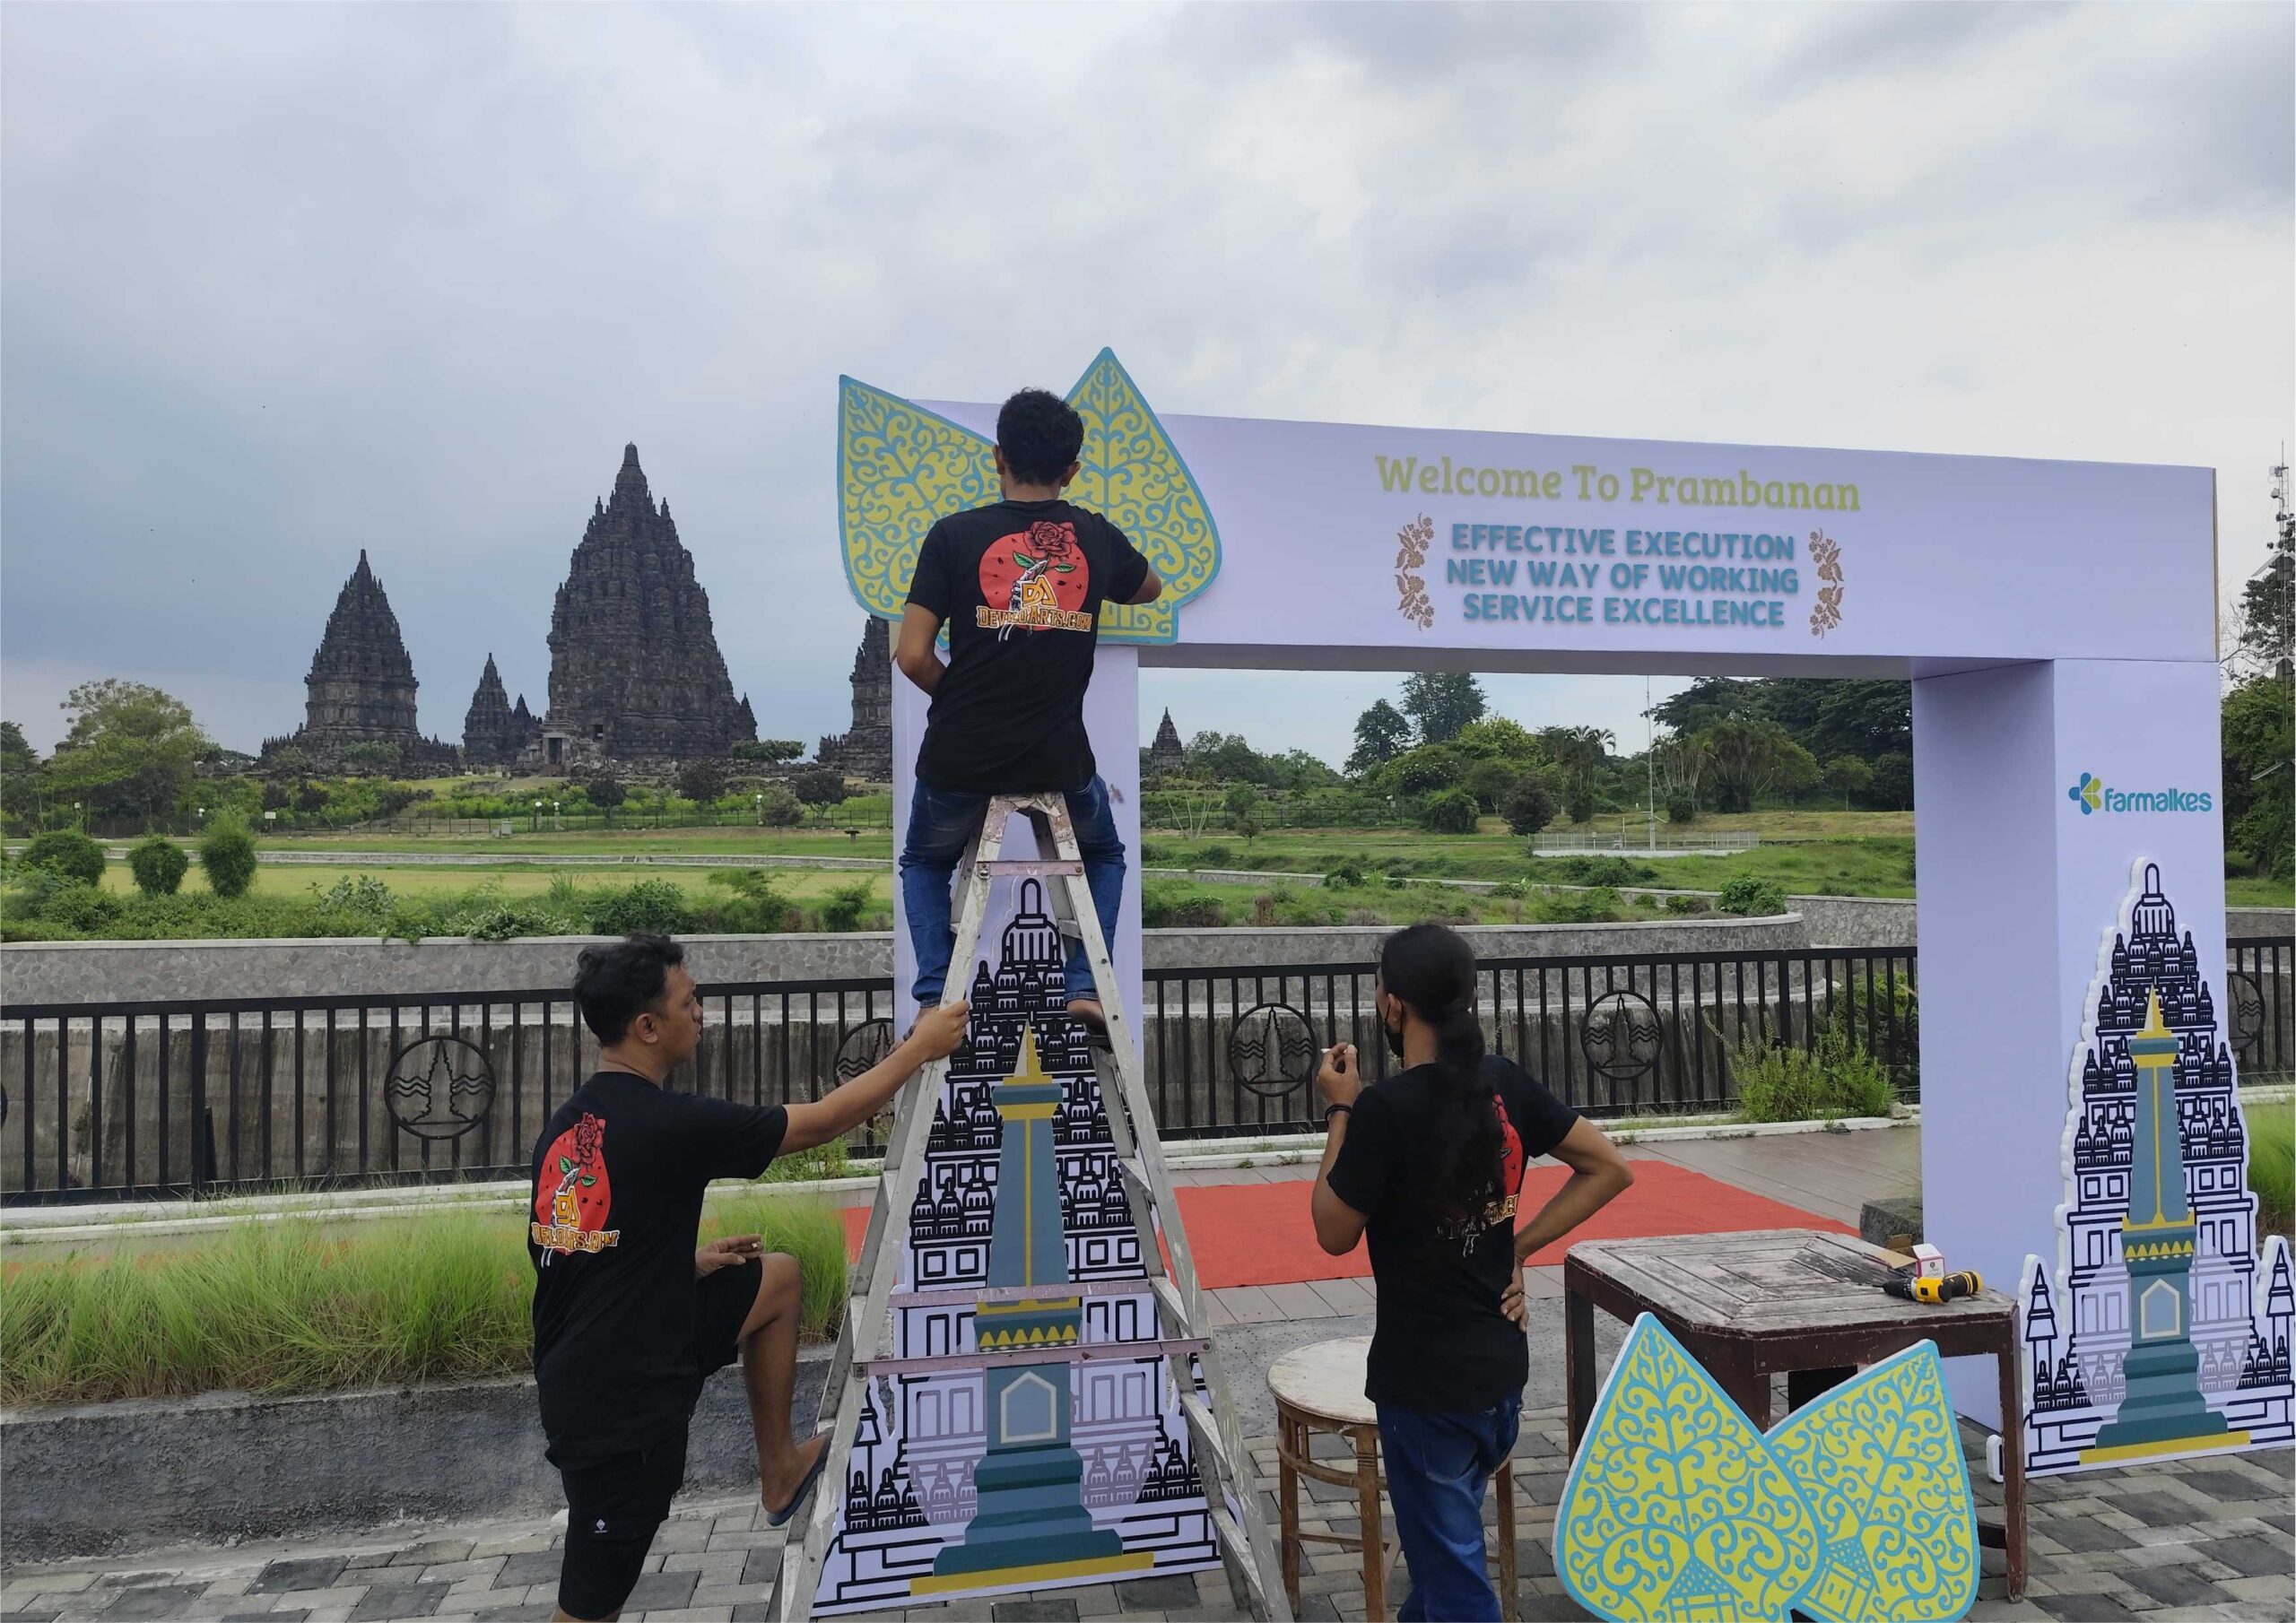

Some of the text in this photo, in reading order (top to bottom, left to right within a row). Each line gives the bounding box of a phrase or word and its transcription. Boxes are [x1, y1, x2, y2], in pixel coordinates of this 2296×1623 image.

[1375, 455, 1861, 511] Welcome To Prambanan
[1451, 523, 1795, 560] EFFECTIVE EXECUTION
[1446, 558, 1799, 595] NEW WAY OF WORKING
[1463, 593, 1785, 627] SERVICE EXCELLENCE
[2104, 787, 2213, 812] farmalkes
